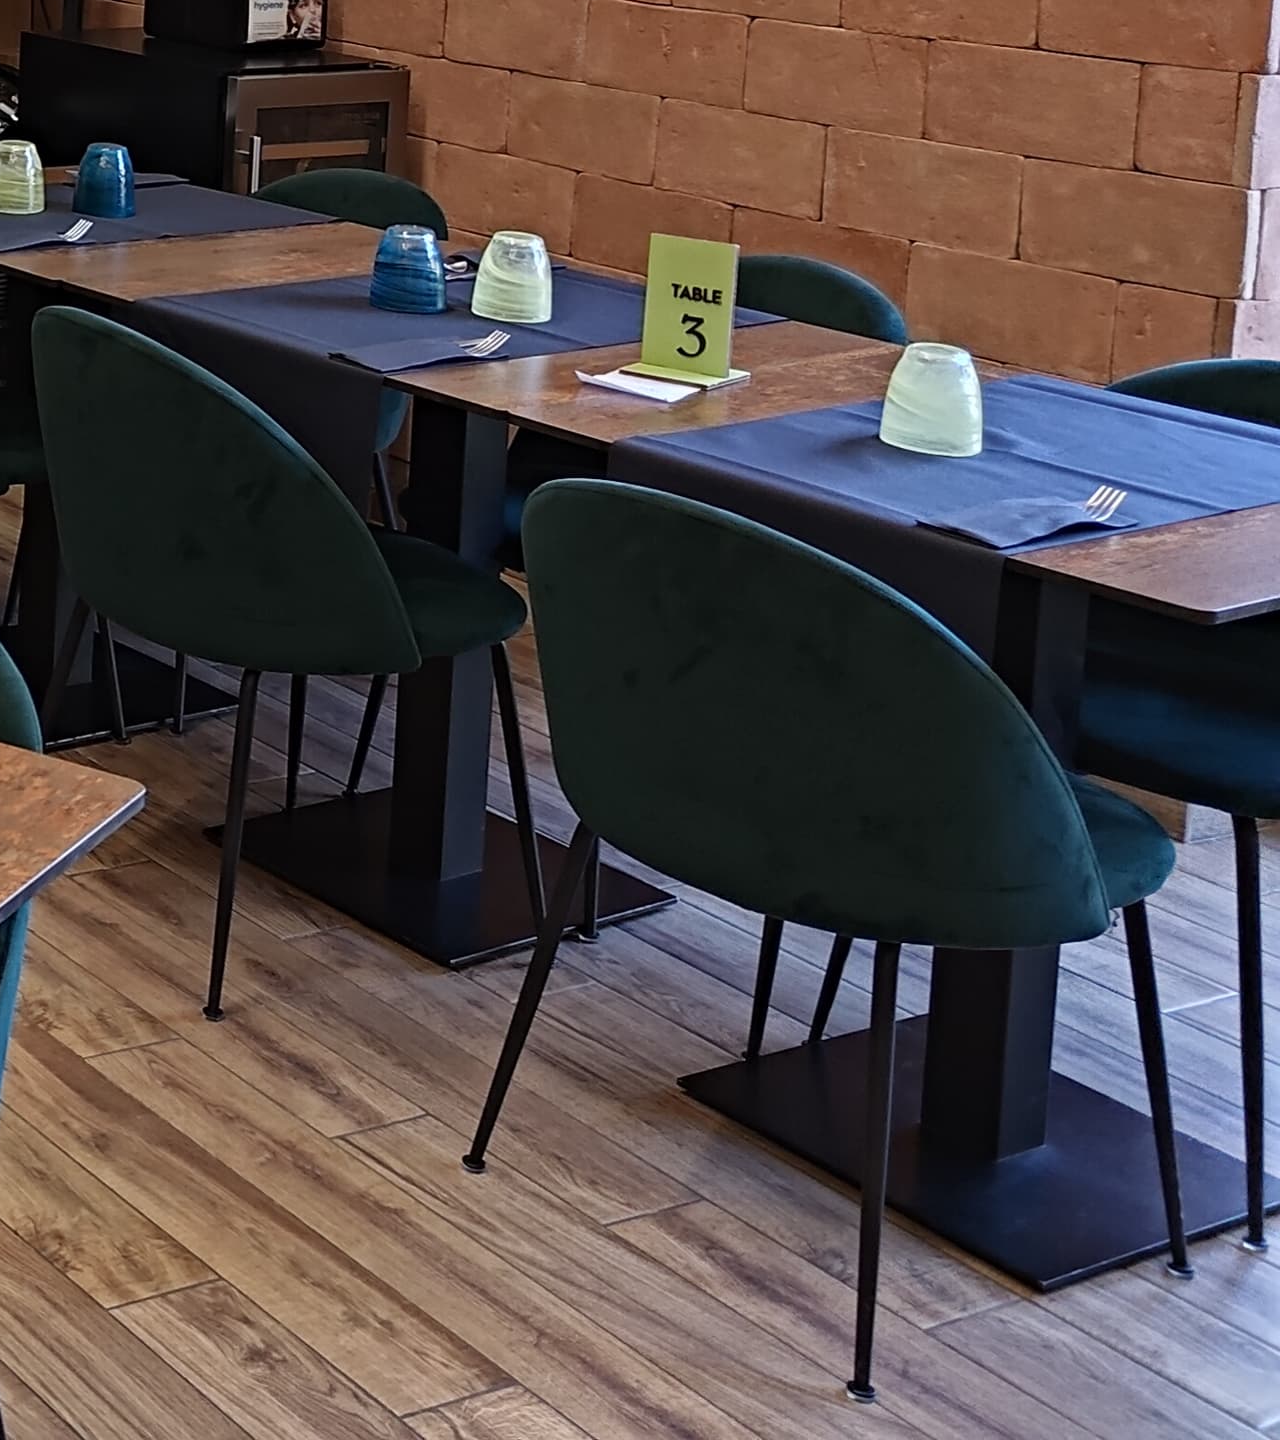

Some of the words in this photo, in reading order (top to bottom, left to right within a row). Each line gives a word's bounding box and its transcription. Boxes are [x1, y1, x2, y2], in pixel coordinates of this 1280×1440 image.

[254, 0, 284, 11] hygiene
[671, 282, 723, 306] TABLE
[676, 313, 707, 358] 3
